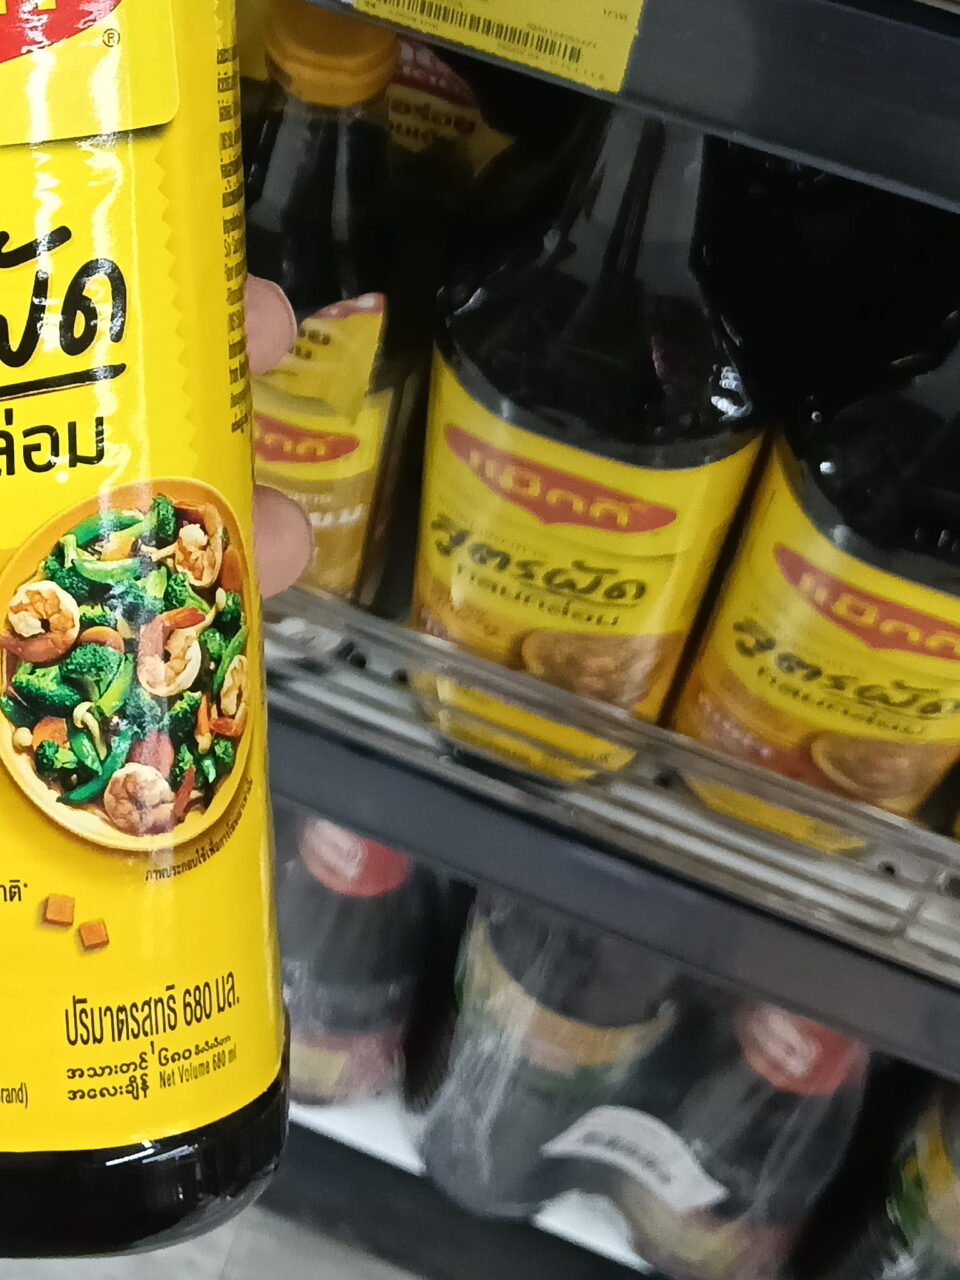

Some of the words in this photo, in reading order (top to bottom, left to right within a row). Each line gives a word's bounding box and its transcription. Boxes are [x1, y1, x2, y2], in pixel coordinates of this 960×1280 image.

[64, 983, 178, 1055] ปริมาตรสุทธิ
[182, 981, 213, 1027] 680
[215, 970, 240, 1014] มล.
[159, 1069, 176, 1089] Net
[178, 1060, 210, 1083] Volume
[212, 1049, 227, 1071] 680
